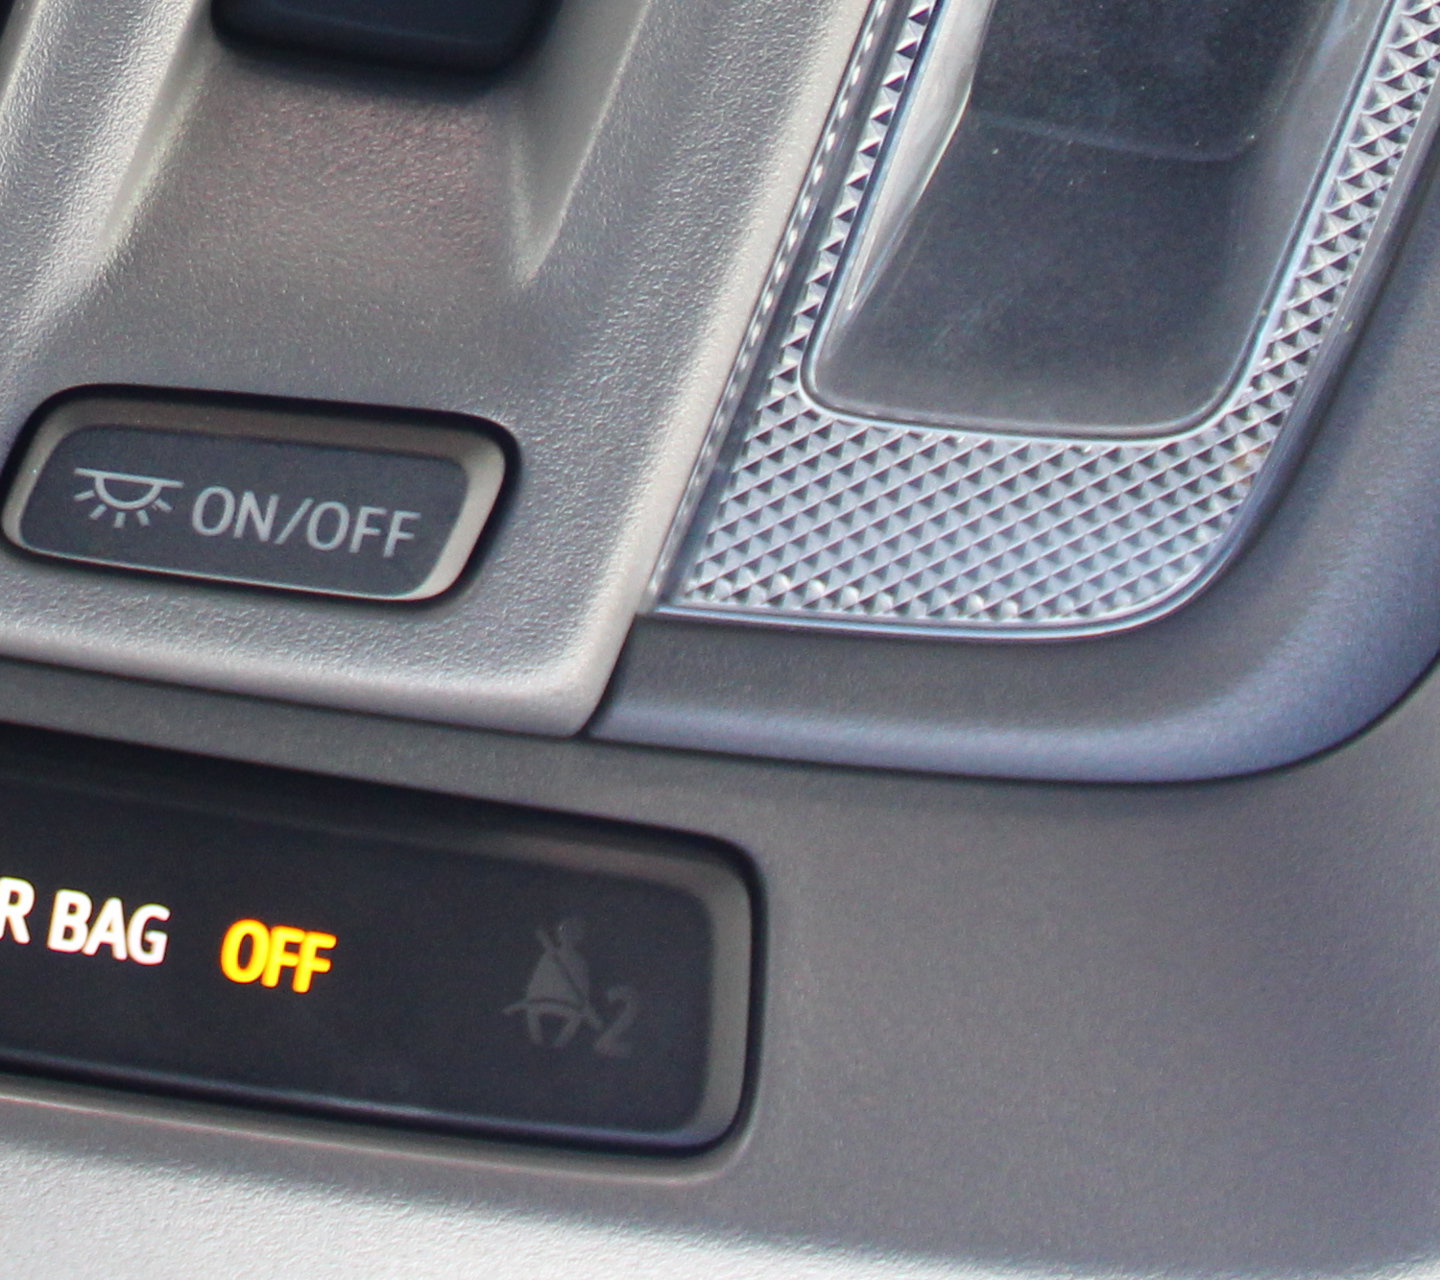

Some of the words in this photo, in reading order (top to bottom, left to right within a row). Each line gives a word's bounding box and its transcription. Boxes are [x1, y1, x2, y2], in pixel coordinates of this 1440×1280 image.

[191, 485, 421, 558] ON/OFF
[47, 889, 171, 966] BAG
[219, 917, 338, 994] OFF
